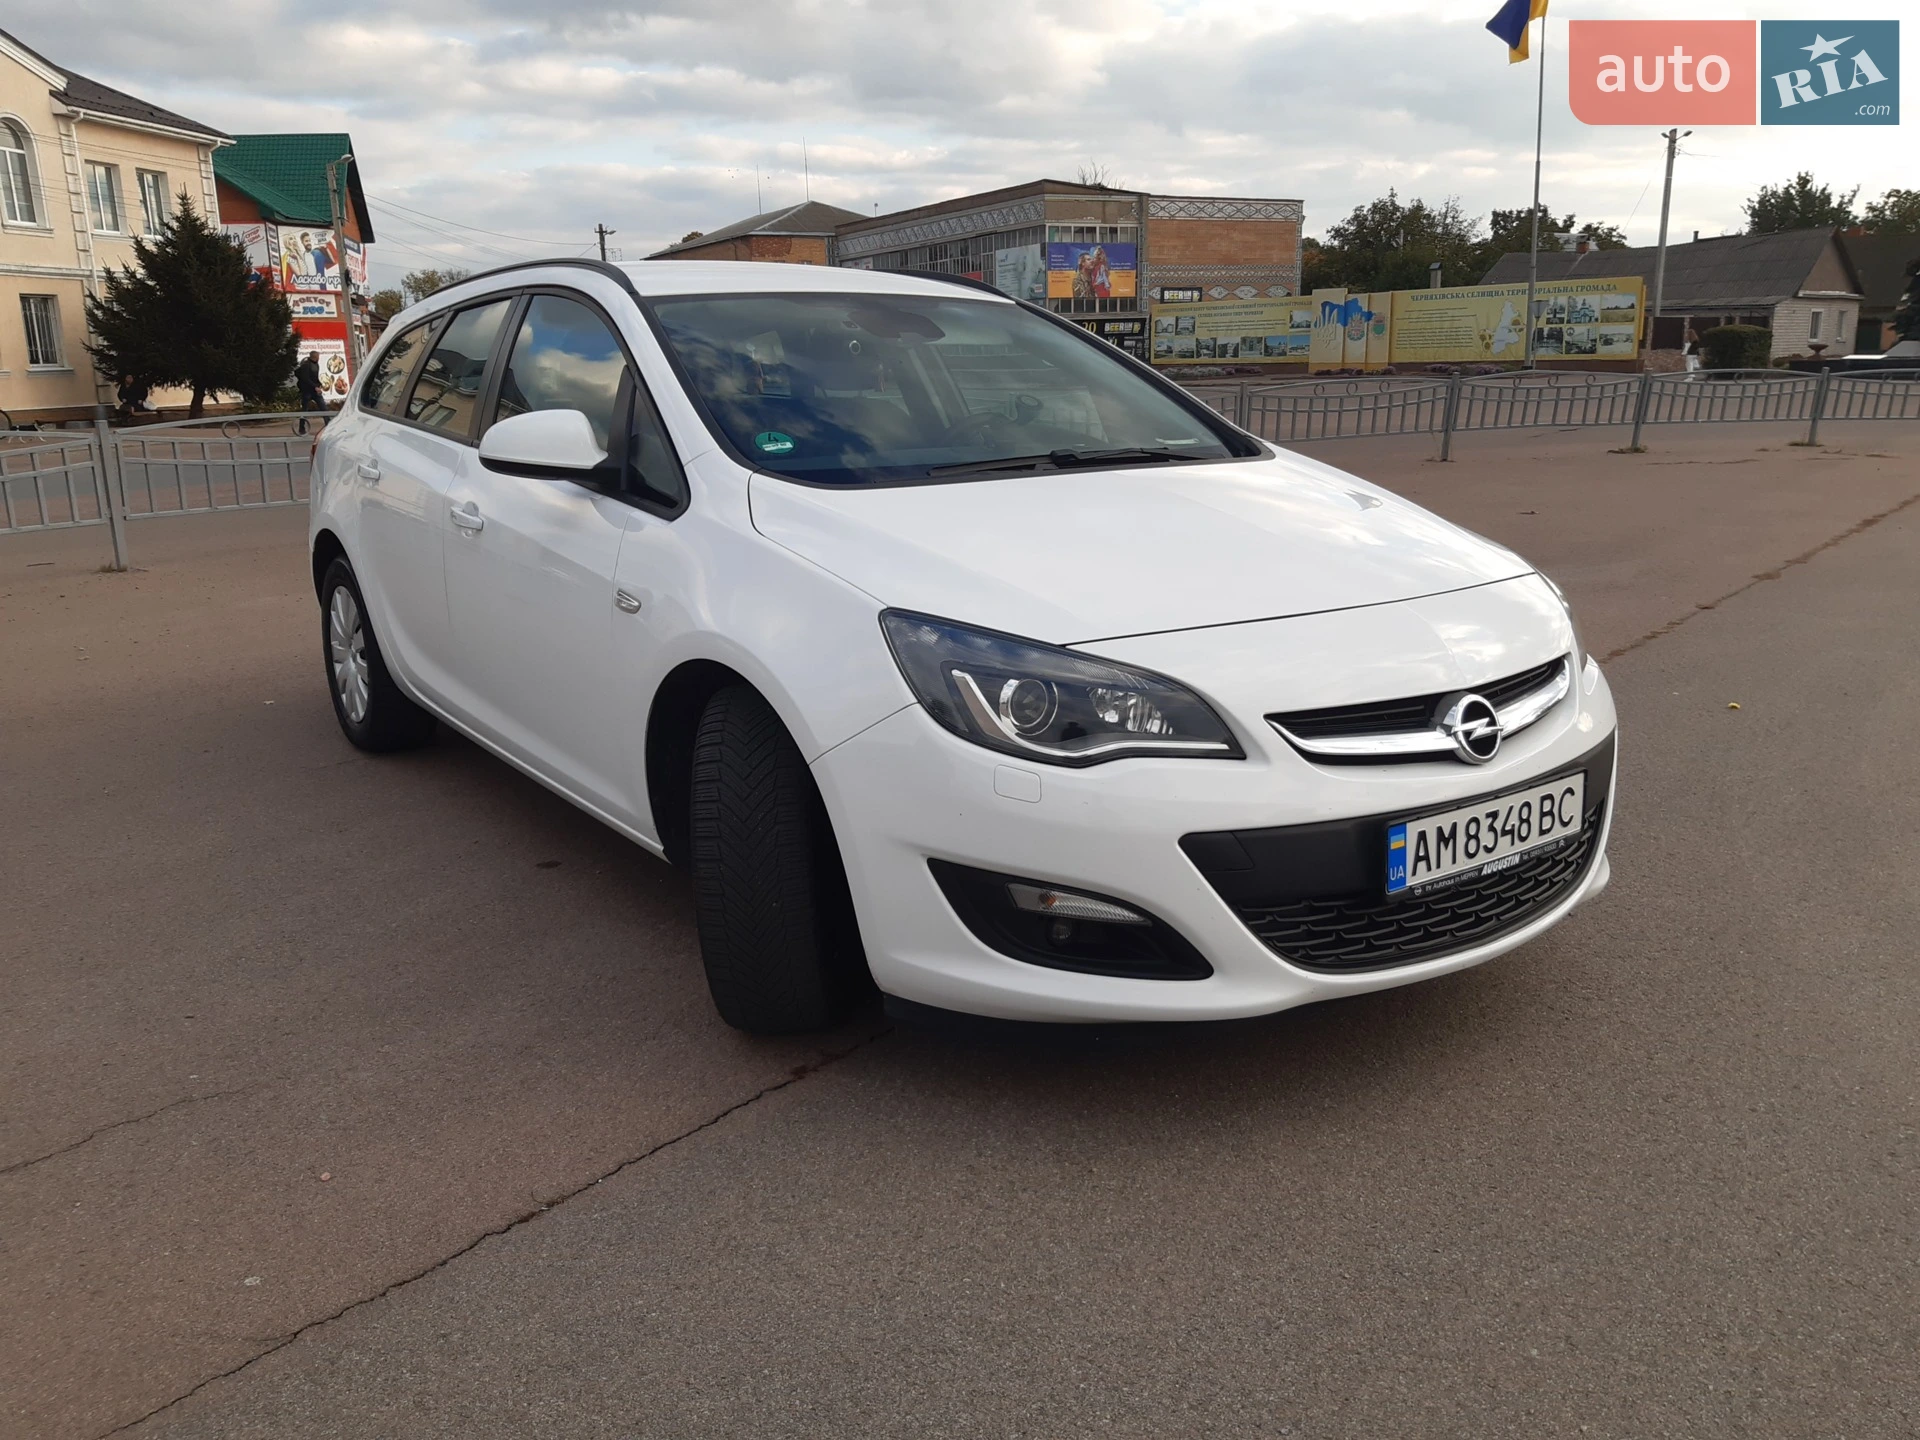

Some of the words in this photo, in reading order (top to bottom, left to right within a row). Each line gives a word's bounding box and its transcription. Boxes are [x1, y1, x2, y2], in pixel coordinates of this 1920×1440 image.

[290, 272, 327, 286] Ласкаво
[1410, 291, 1465, 302] ЧЕРНЯХІВСЬКА
[1466, 289, 1505, 299] СЕЛИЩНА
[1575, 283, 1618, 293] ГРОМАДА
[292, 296, 331, 307] ДОКТОР
[1481, 853, 1521, 876] AUGUSTIN
[1389, 865, 1405, 881] UA
